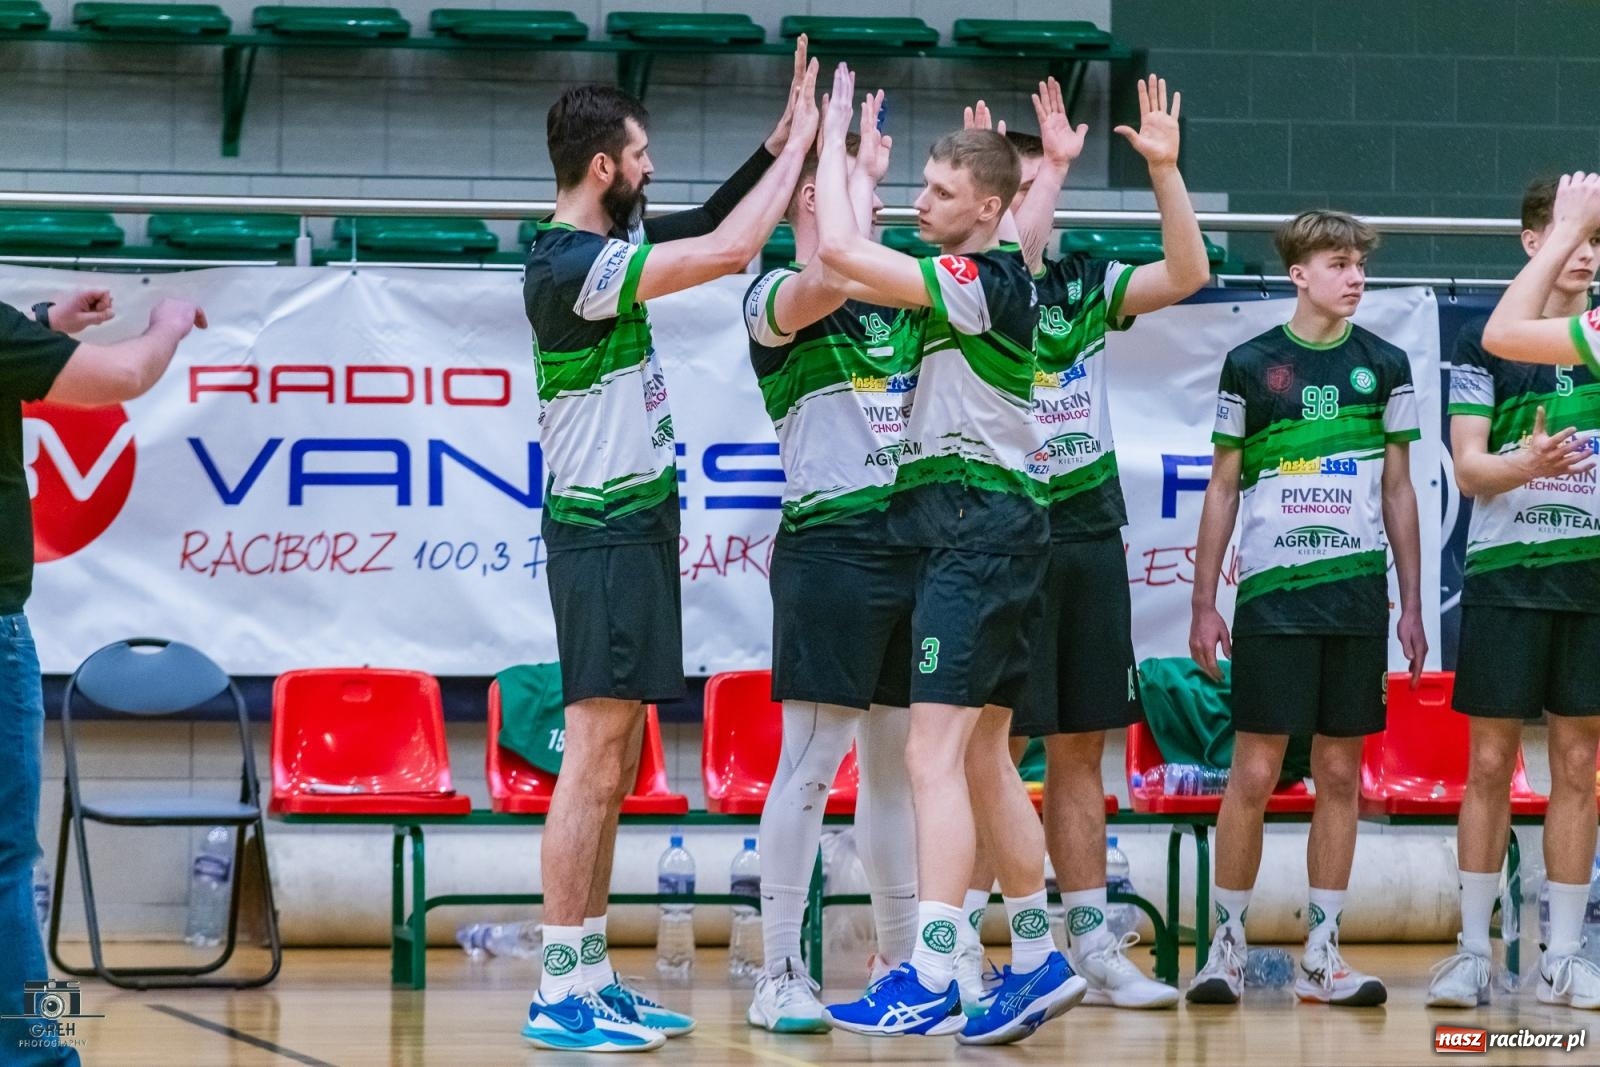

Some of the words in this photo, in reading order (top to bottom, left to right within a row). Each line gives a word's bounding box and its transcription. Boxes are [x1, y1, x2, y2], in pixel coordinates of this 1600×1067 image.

[189, 365, 512, 407] RADIO
[1556, 364, 1574, 397] 5
[1302, 385, 1339, 420] 98
[1281, 487, 1352, 504] PIVEXIN
[1281, 504, 1351, 514] TECHNOLOGY
[413, 540, 511, 576] 100,3
[919, 637, 940, 673] 3
